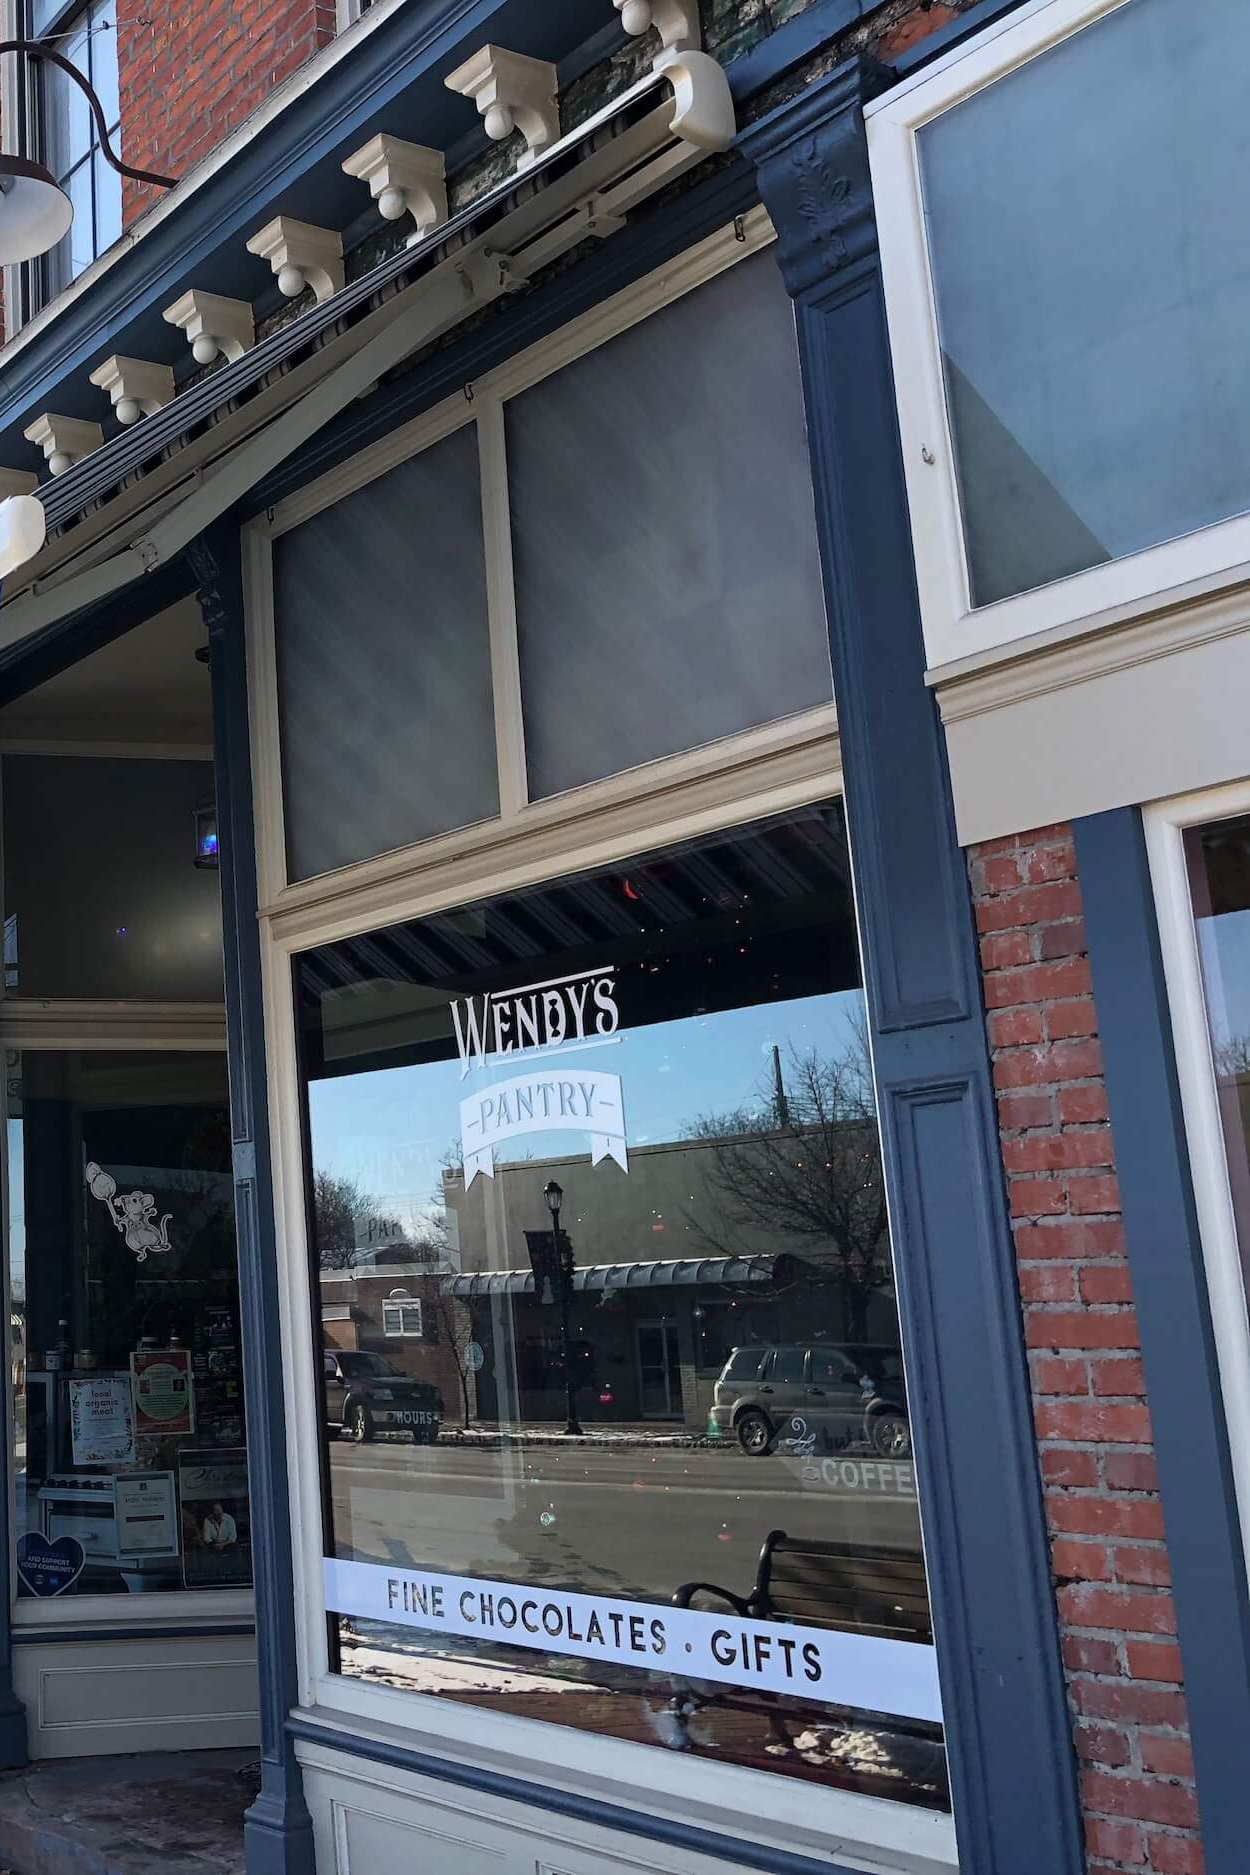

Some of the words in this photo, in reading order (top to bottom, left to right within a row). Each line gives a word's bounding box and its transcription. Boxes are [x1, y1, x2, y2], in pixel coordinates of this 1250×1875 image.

[449, 978, 619, 1081] WENDY'S
[479, 1081, 597, 1135] PANTRY
[387, 1578, 445, 1617] FINE
[459, 1590, 667, 1655] CHOCOLATES
[711, 1629, 822, 1682] GIFTS
